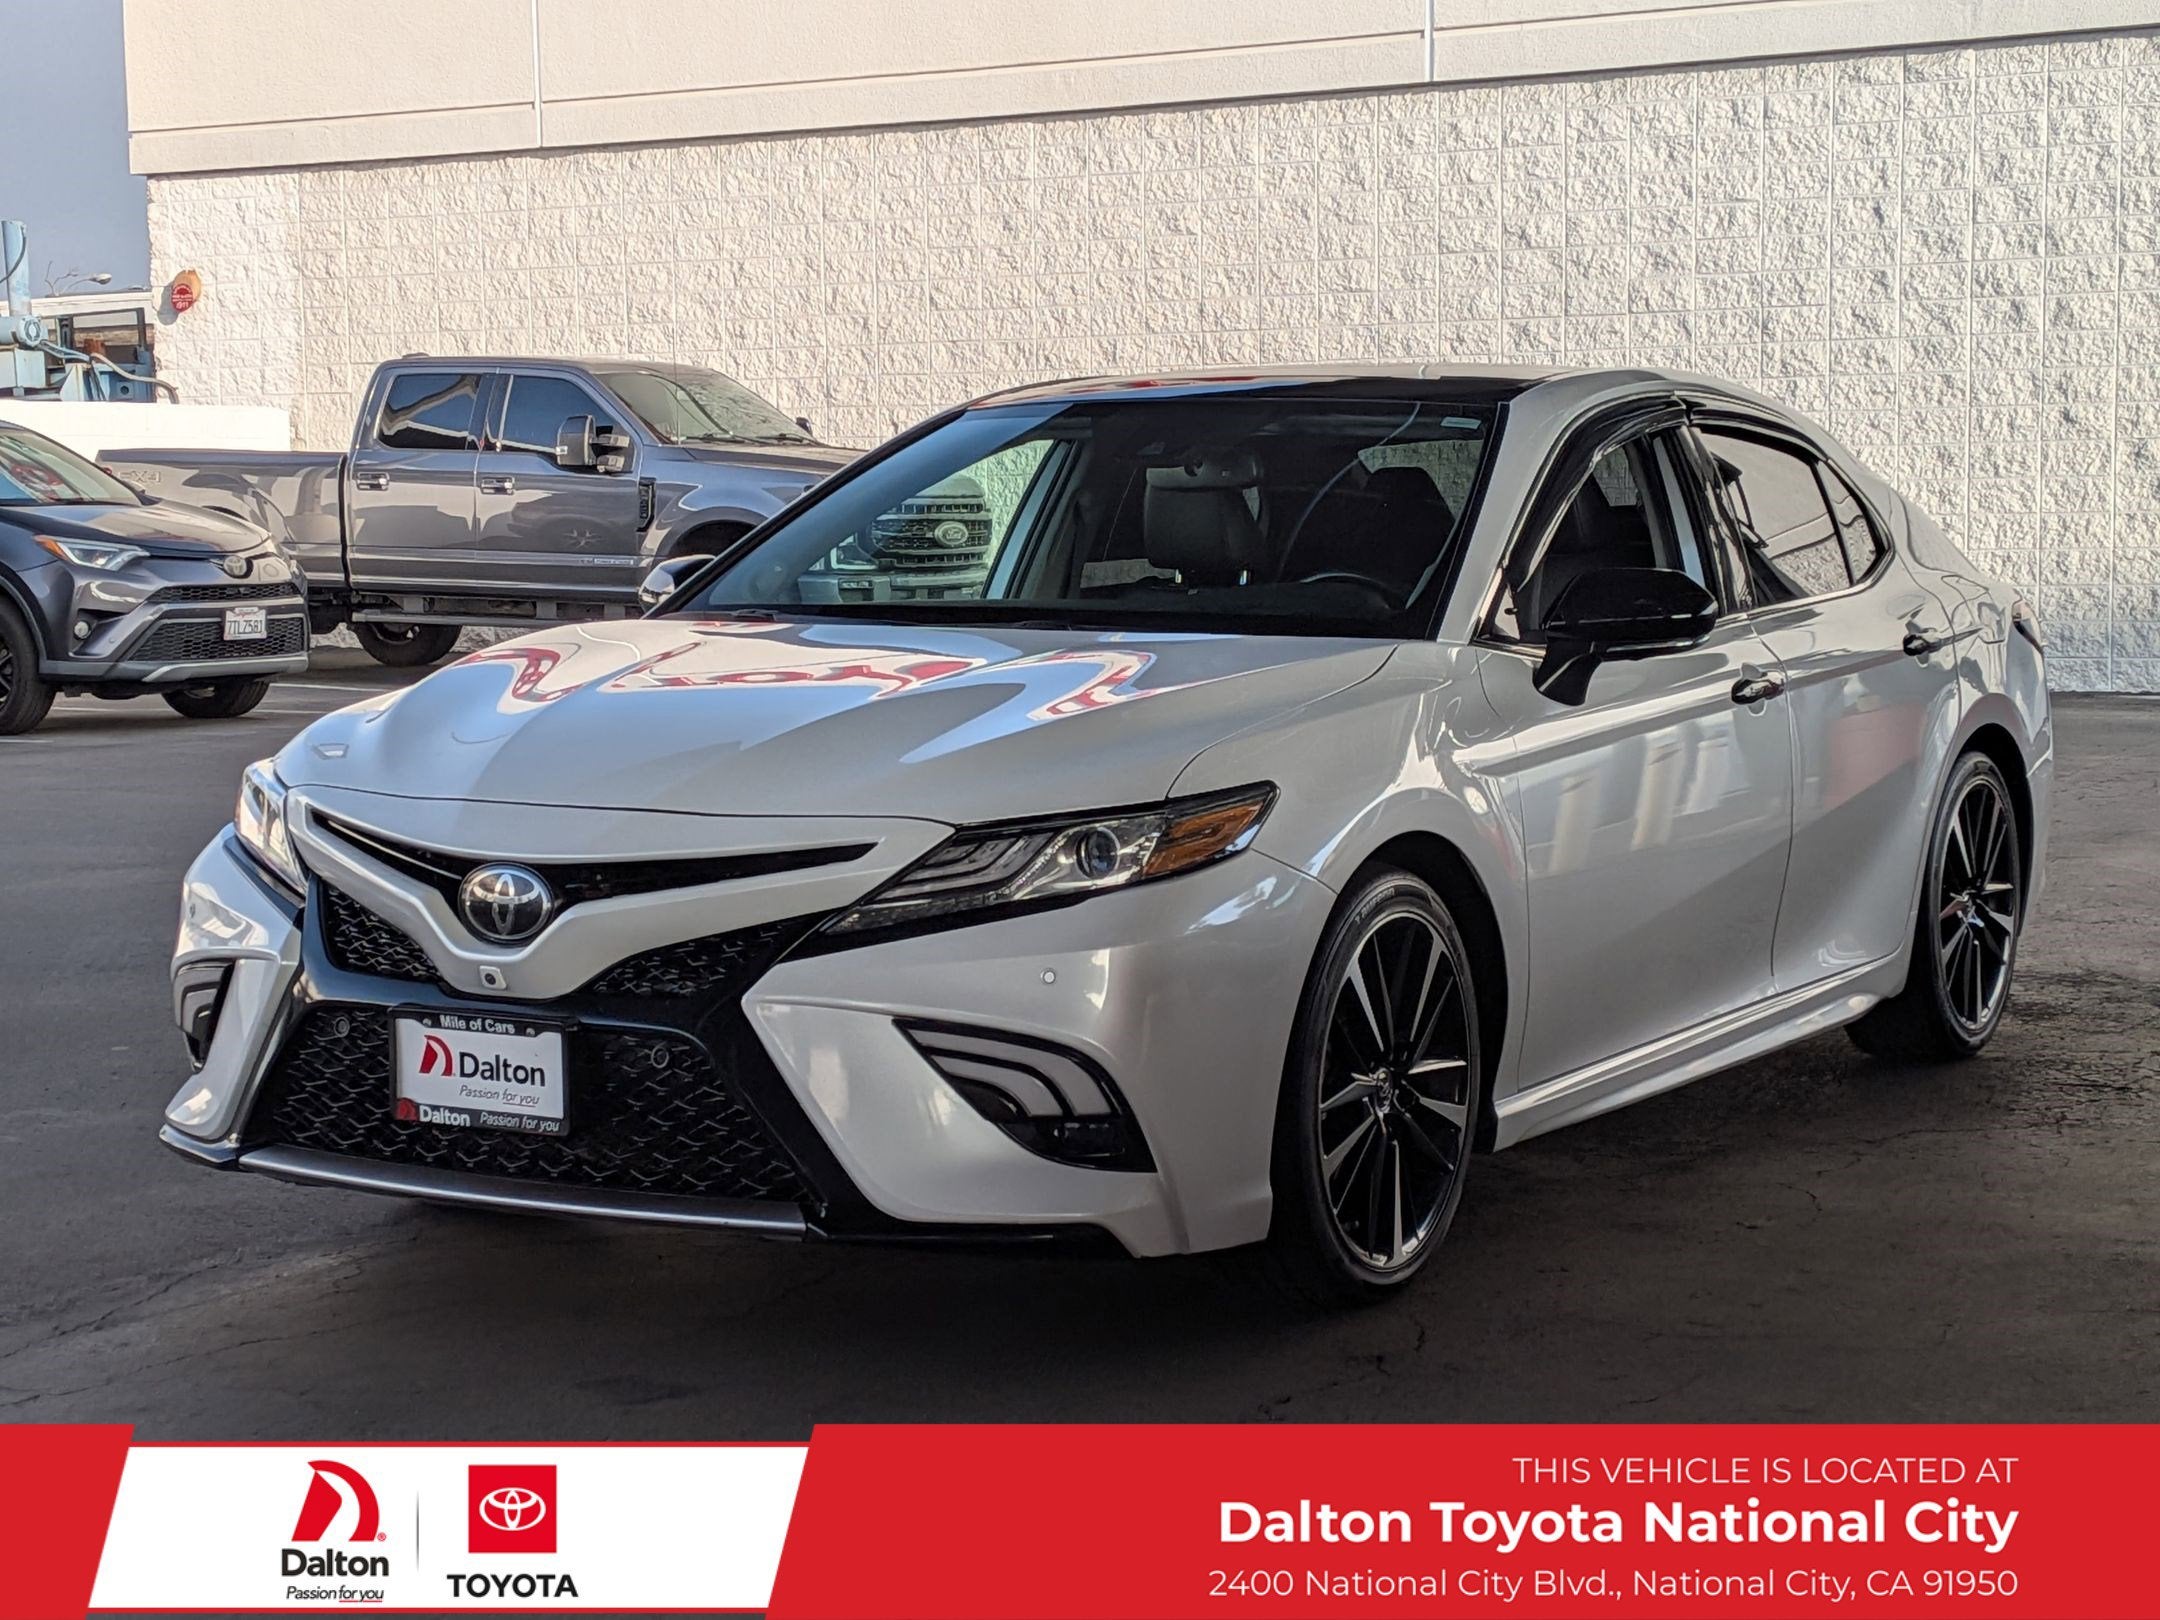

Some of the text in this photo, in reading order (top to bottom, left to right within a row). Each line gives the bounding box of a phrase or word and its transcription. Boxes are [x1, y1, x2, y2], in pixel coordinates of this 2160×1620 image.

[439, 1014, 515, 1034] Mile of Cars
[459, 1051, 545, 1087] Dalton
[459, 1084, 539, 1105] Passion for you
[419, 1105, 560, 1133] Dalton Passion for you
